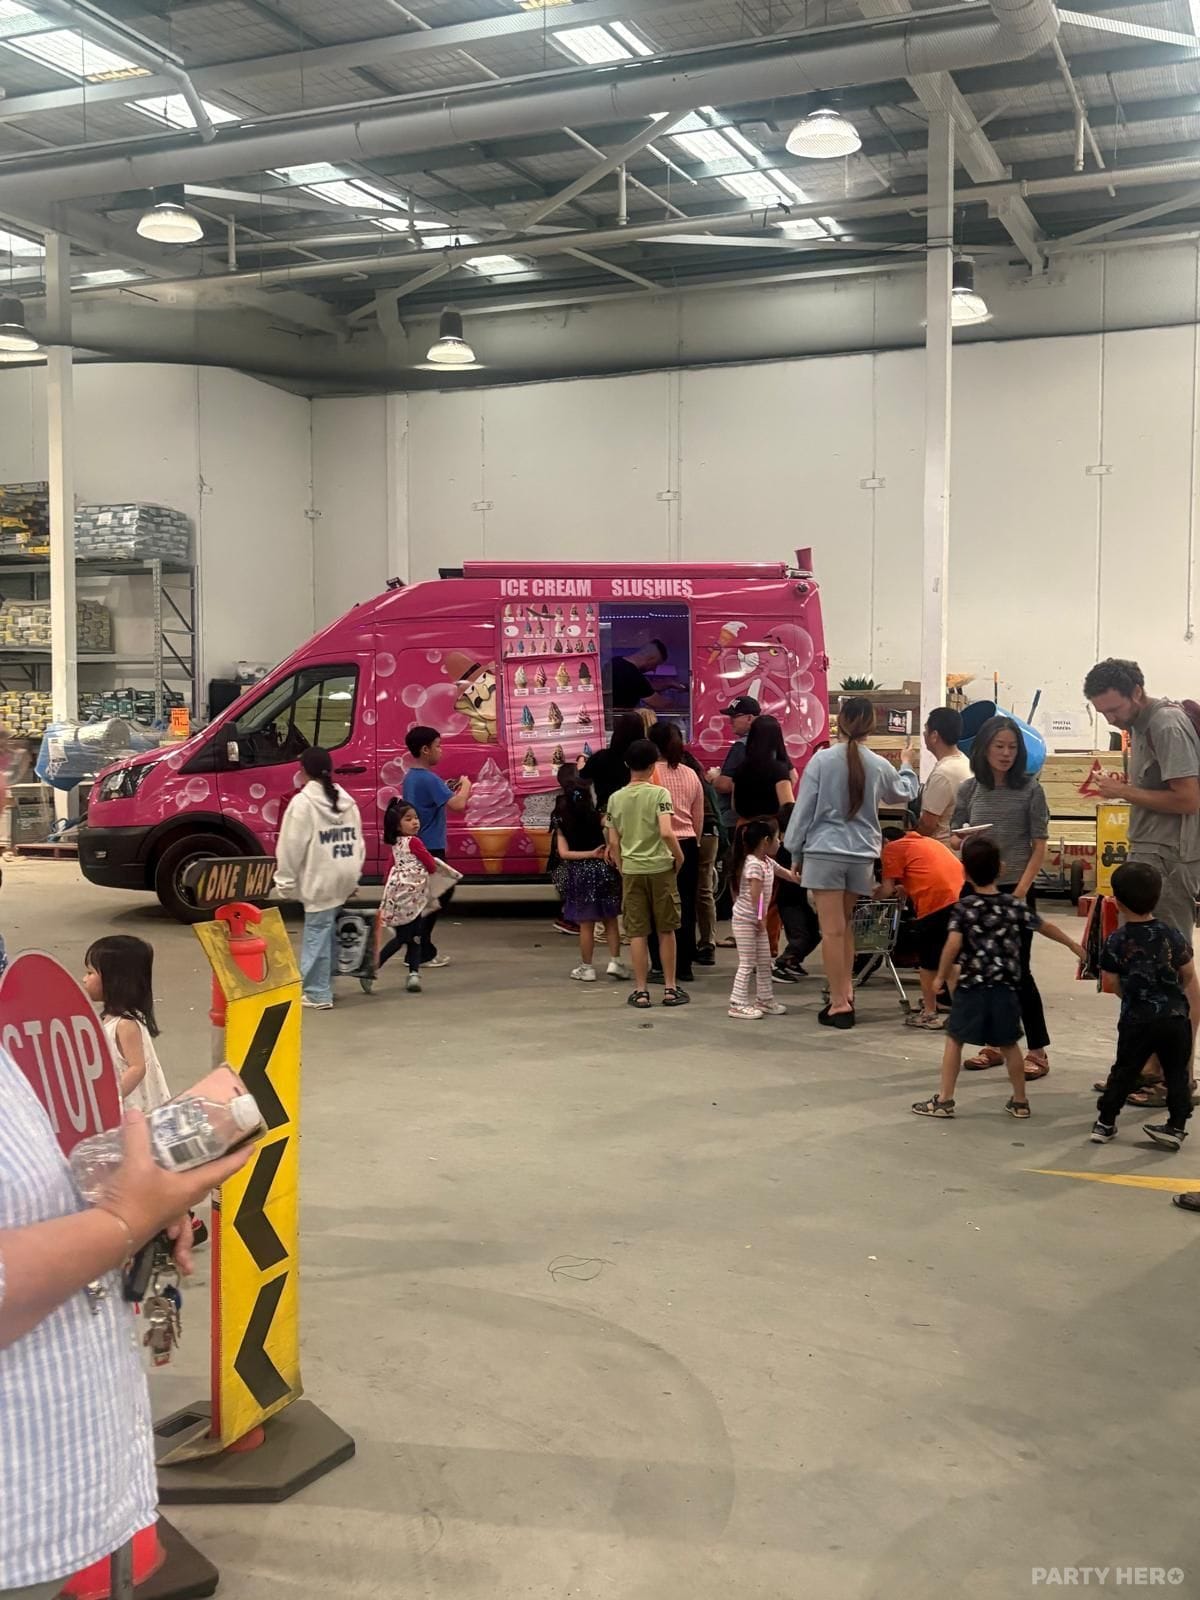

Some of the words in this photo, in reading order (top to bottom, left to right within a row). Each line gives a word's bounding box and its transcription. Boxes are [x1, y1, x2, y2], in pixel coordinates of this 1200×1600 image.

[500, 579, 529, 596] ICE
[532, 579, 592, 596] CREAM
[611, 579, 694, 597] SLUSHIES
[1107, 813, 1128, 825] AE
[319, 827, 357, 845] WHITE
[332, 844, 354, 859] FOX
[205, 863, 241, 901] ONE
[244, 862, 277, 898] WAY
